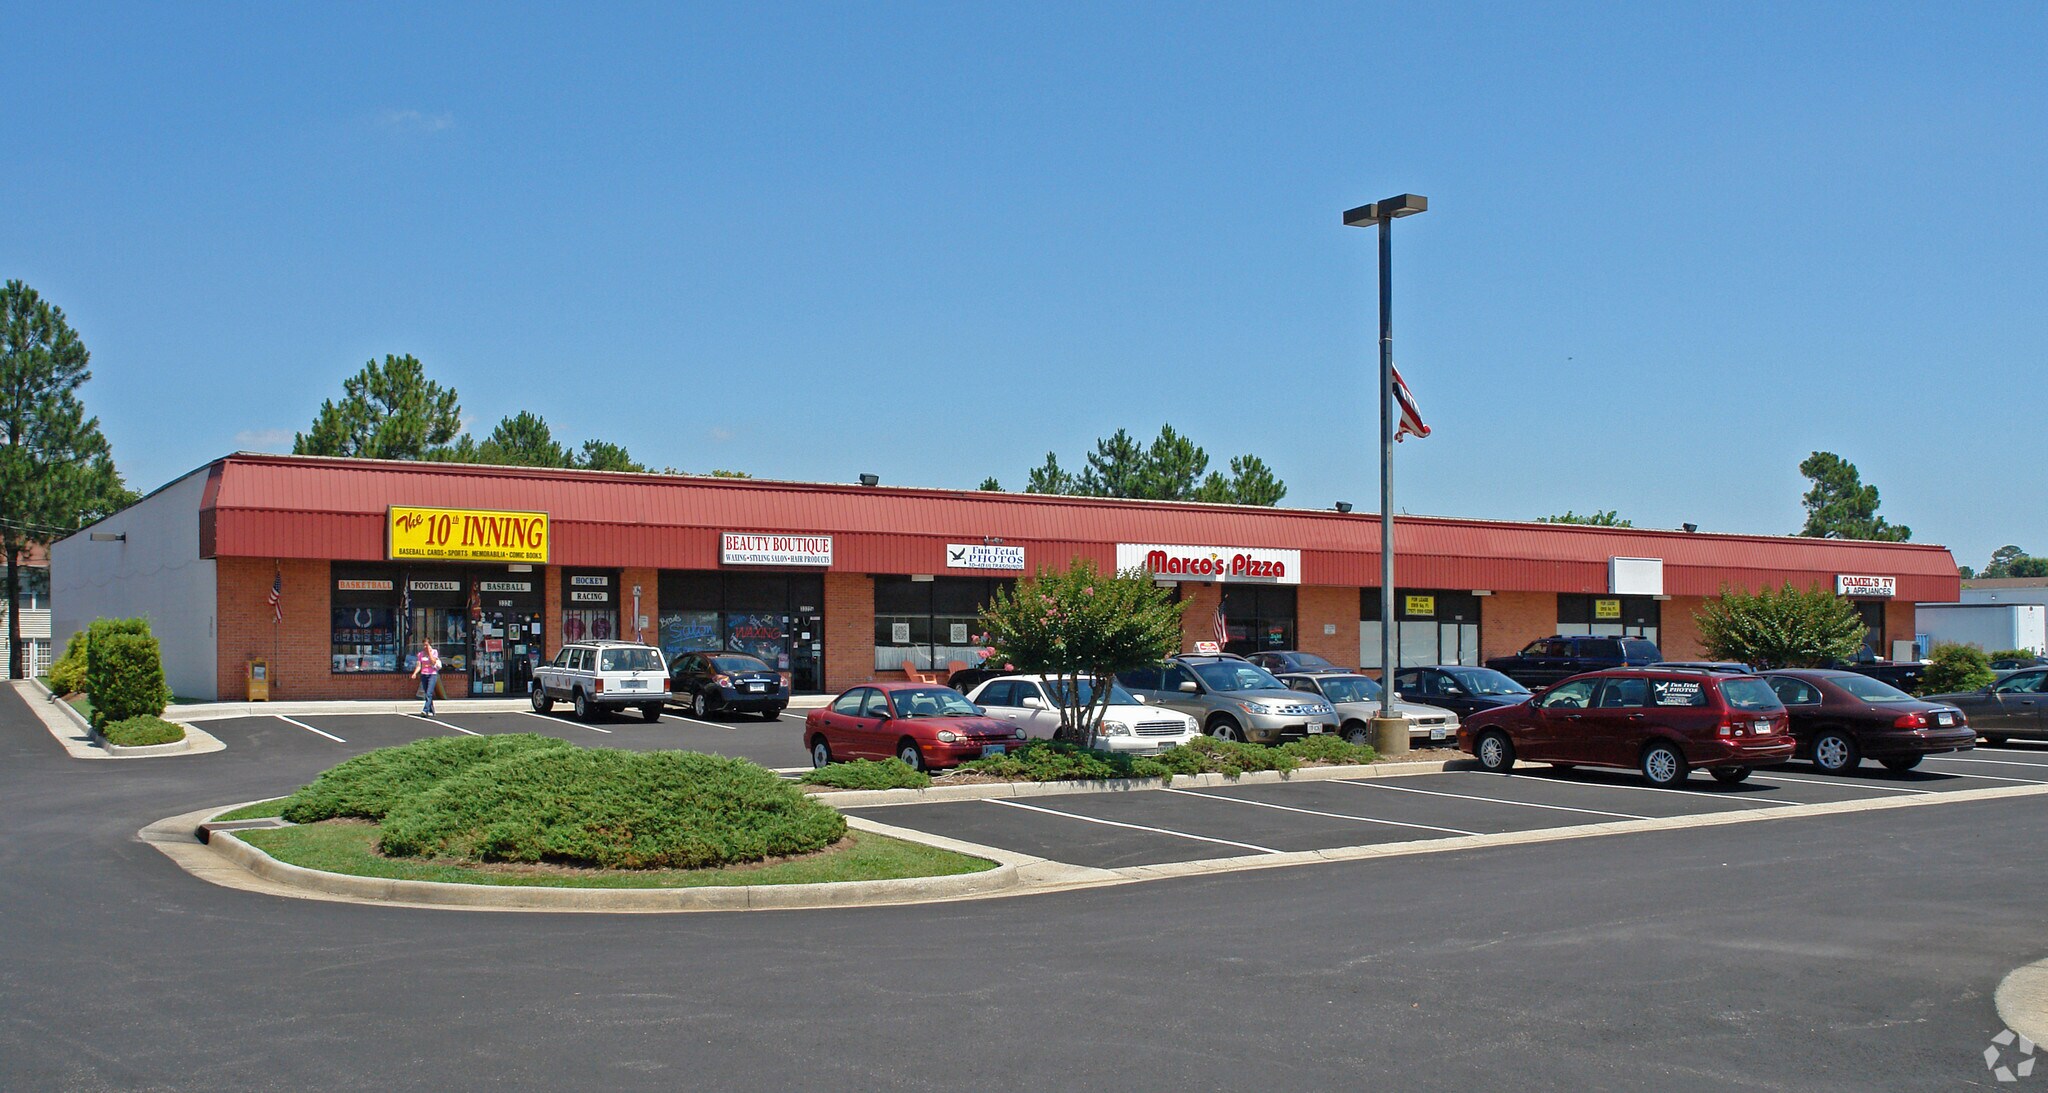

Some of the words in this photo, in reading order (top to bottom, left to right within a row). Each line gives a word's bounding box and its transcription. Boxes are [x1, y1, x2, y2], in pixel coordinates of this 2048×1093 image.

[395, 512, 424, 533] The
[461, 515, 544, 549] INNING
[725, 535, 770, 551] BEAUTY
[772, 537, 830, 555] BOUTIQUE
[398, 548, 426, 556] BASEBALL
[427, 548, 444, 556] CARDS
[447, 549, 468, 557] SPORTS
[472, 550, 506, 558] MEMORABILIA
[509, 551, 525, 559] COMIC
[526, 551, 543, 559] BOOKS
[972, 546, 991, 555] Fun
[995, 547, 1019, 556] Fetal
[725, 554, 747, 562] WAXING
[771, 555, 788, 563] SALON
[790, 555, 803, 563] HAIR
[804, 555, 830, 564] PRODUCTS
[969, 554, 1024, 564] PHOTOS
[1147, 550, 1224, 576] Marco's
[1232, 553, 1285, 578] Pizza
[340, 581, 392, 589] BASKETBALL
[414, 582, 453, 590] FOOTBALL
[575, 577, 604, 585] HOCKEY
[1843, 577, 1879, 587] CAMEL'S
[1882, 579, 1893, 587] TV
[486, 583, 525, 591] BASEBALL
[1853, 587, 1891, 595] APPLIANCES
[735, 626, 780, 639] WAXING
